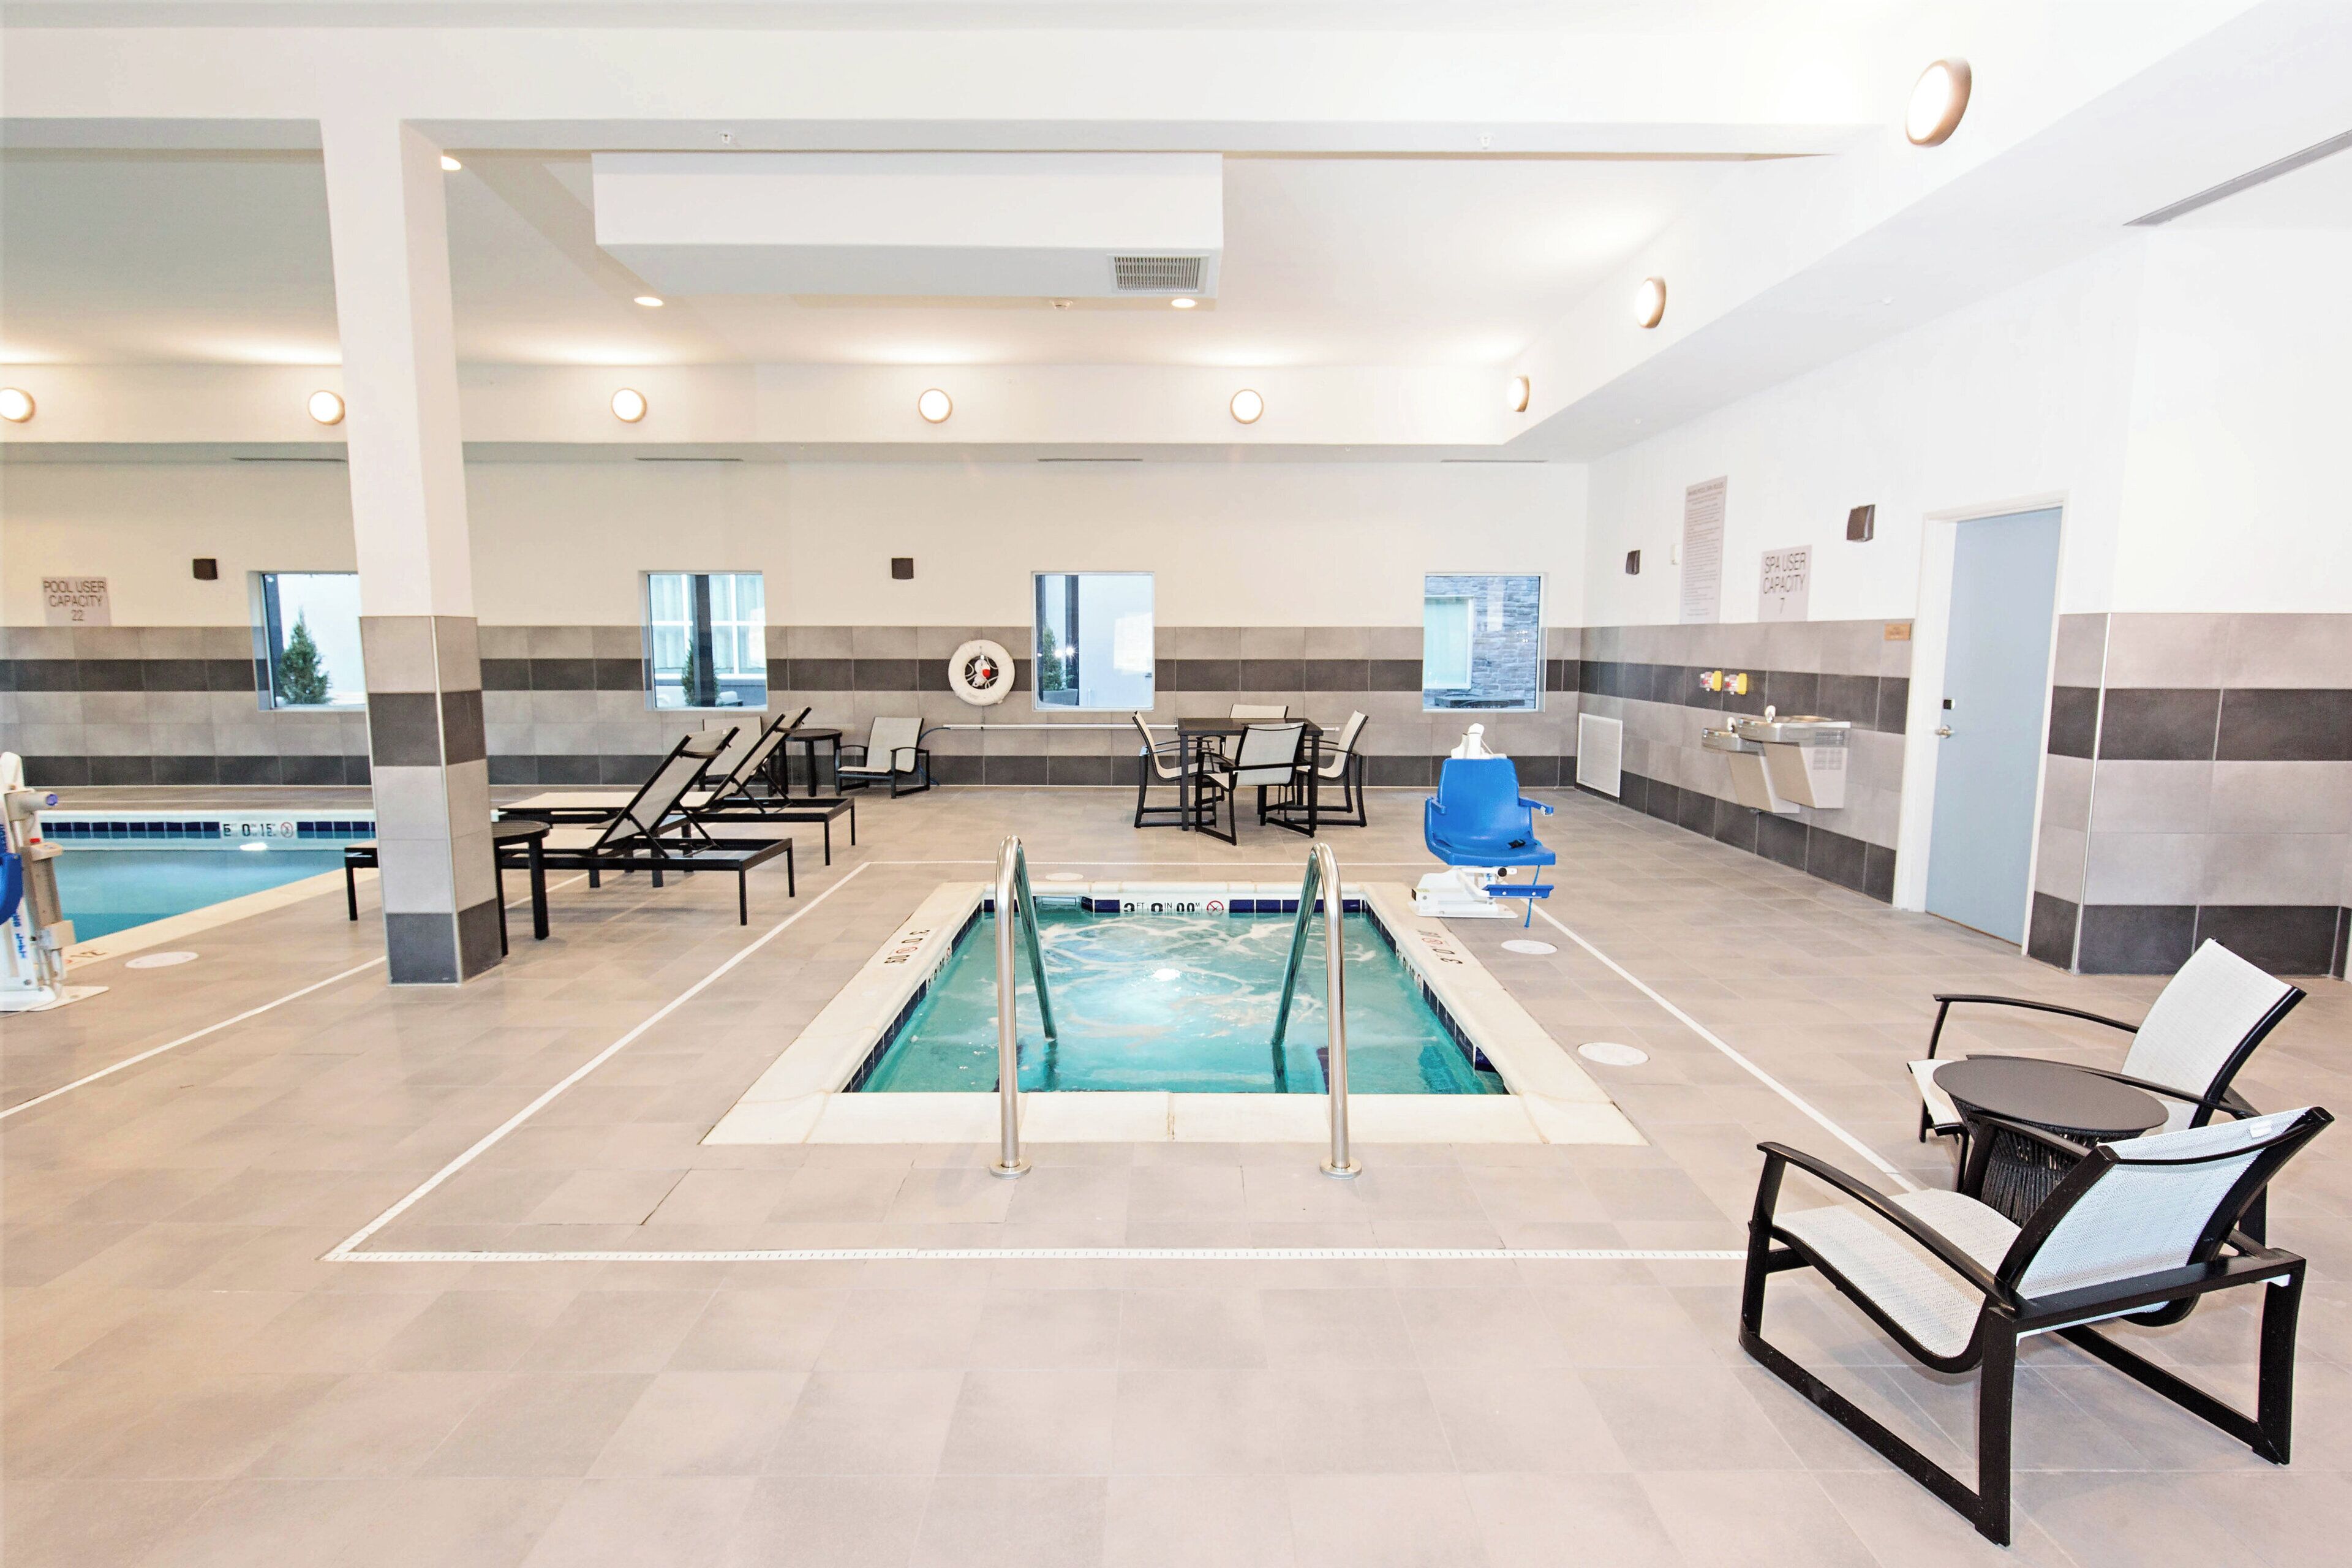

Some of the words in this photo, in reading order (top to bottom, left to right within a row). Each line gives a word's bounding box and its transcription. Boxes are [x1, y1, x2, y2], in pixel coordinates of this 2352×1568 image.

[1765, 556, 1781, 573] SPA
[1782, 552, 1806, 571] USER
[43, 581, 73, 593] POOL
[75, 581, 107, 593] USER
[1763, 575, 1806, 594] CAPACITY
[49, 595, 103, 607] CAPACITY
[1779, 597, 1785, 614] 7
[71, 609, 84, 621] 22
